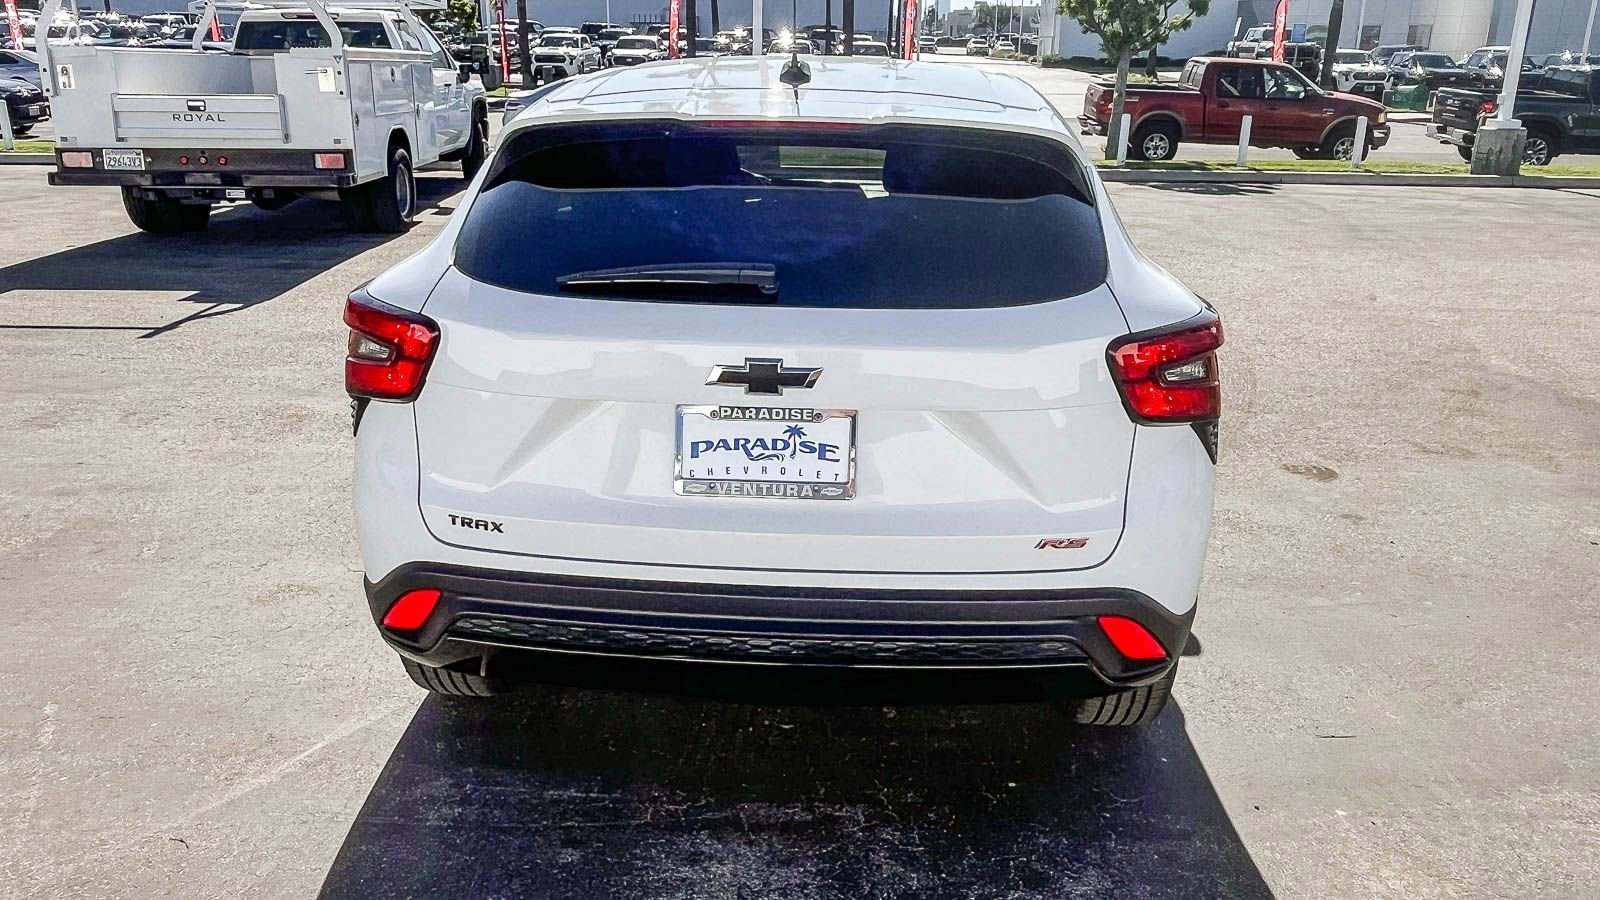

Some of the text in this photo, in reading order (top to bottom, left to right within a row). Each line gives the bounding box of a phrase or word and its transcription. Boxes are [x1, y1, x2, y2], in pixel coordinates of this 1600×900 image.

[172, 113, 226, 122] ROYAL
[720, 407, 813, 421] PARADISE
[690, 425, 841, 463] PARADISE
[689, 466, 840, 481] CHEVROLET
[715, 481, 815, 497] VENTURA
[448, 513, 504, 534] TRAX
[1034, 537, 1089, 549] RS
